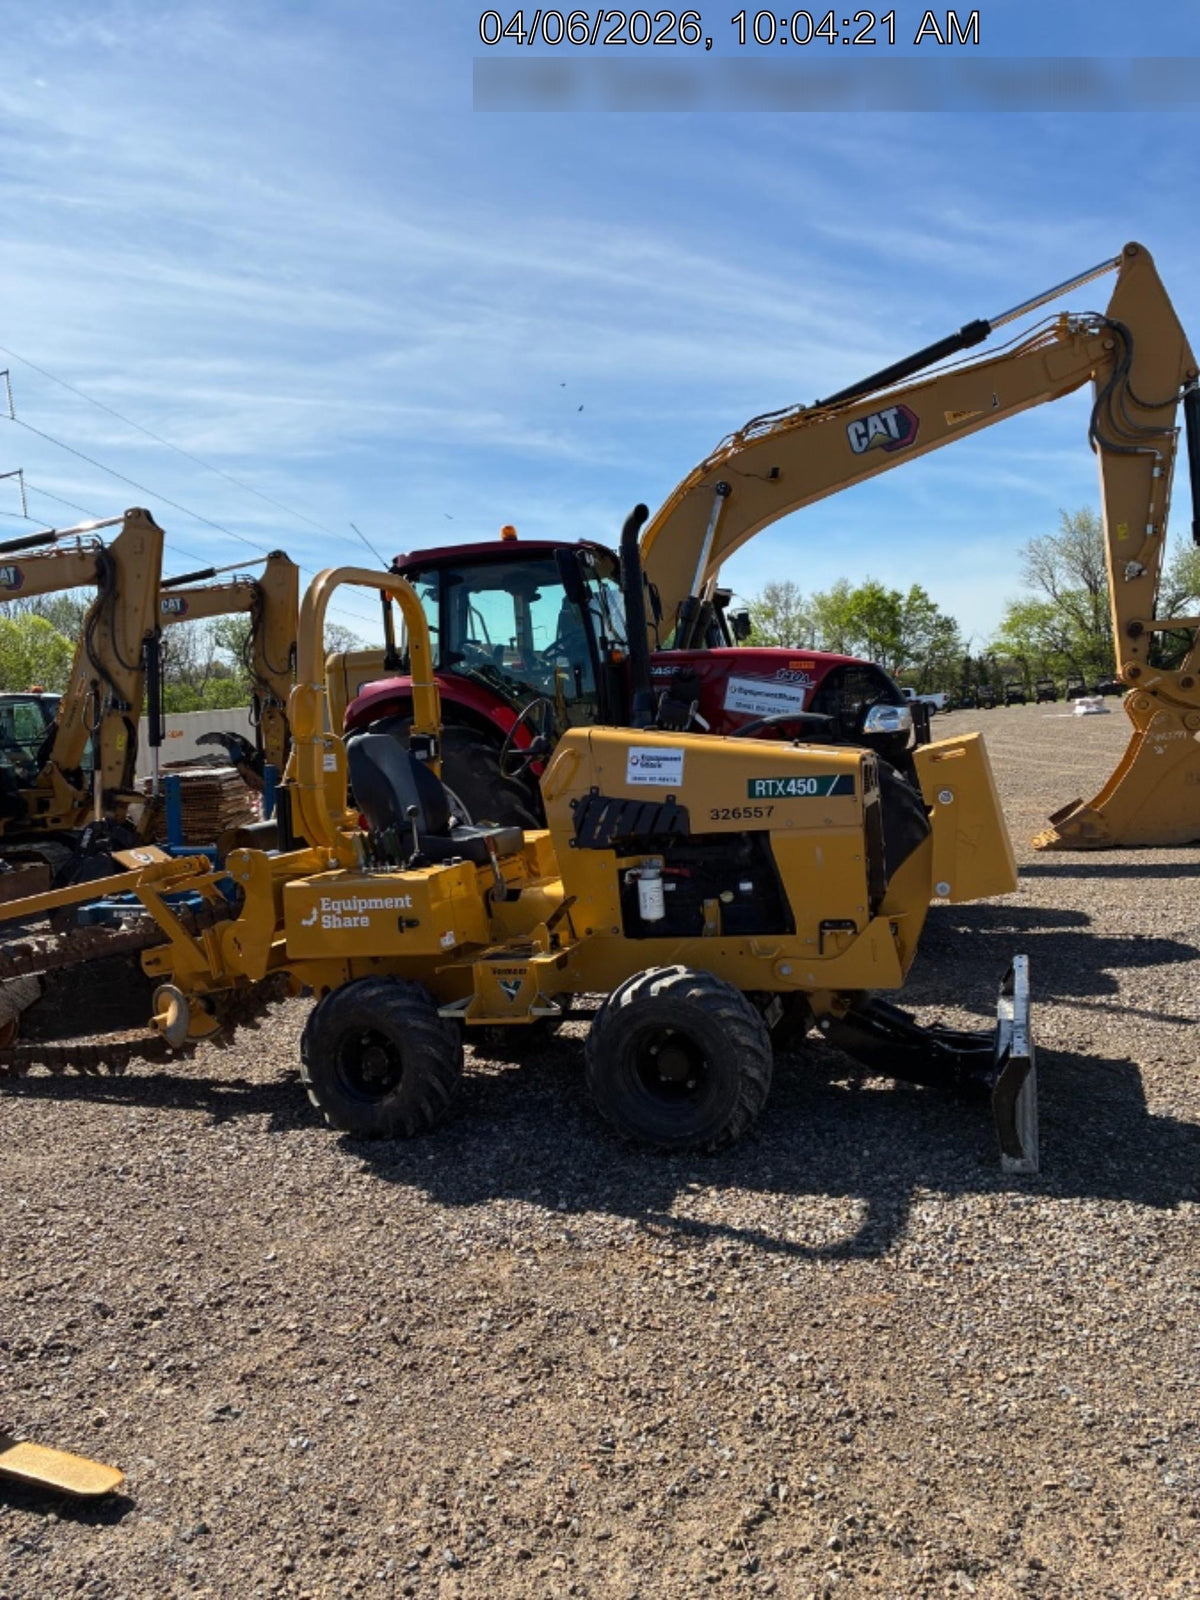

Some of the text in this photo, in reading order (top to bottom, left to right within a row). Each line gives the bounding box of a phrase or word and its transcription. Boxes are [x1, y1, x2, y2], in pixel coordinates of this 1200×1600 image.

[847, 407, 900, 453] CAT
[0, 567, 16, 584] AT
[161, 598, 182, 613] CAT
[710, 805, 775, 821] 326557
[320, 894, 413, 914] Equipment
[321, 914, 370, 929] Share
